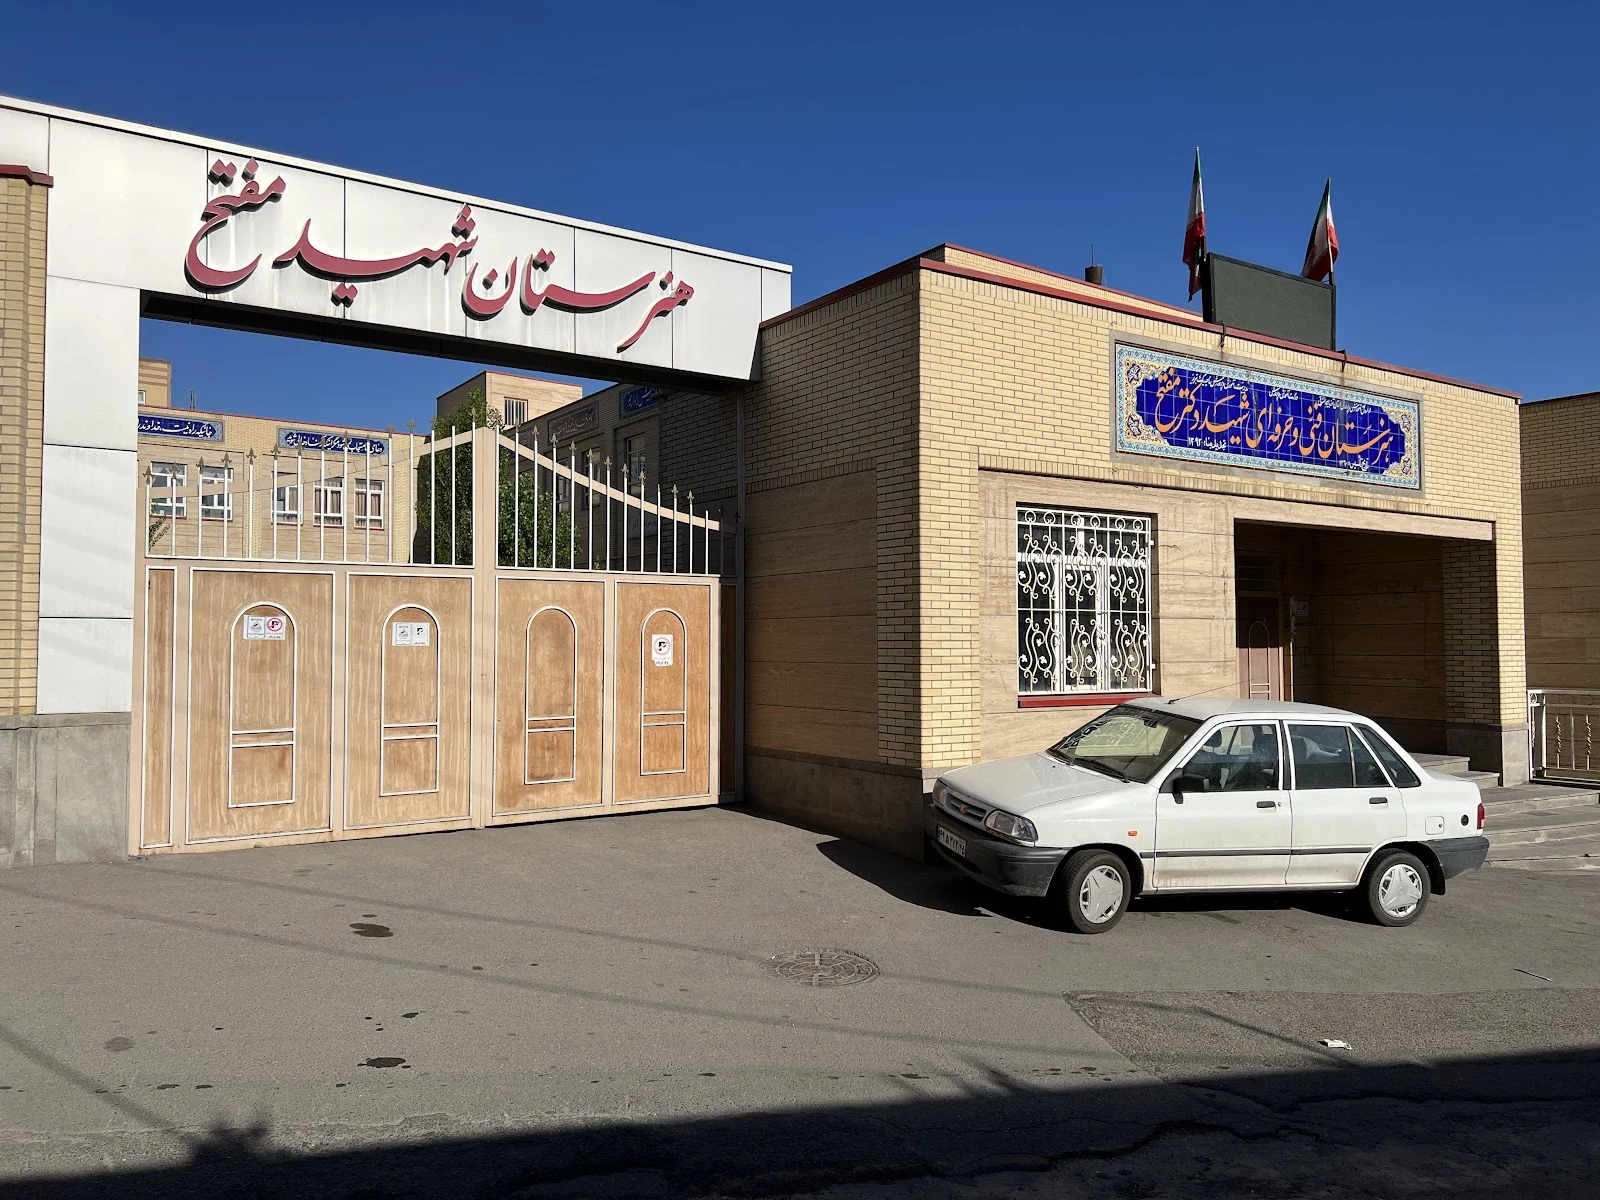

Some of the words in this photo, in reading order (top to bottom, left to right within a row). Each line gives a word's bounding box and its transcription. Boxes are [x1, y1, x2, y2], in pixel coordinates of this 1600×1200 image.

[185, 157, 286, 290] مفتح
[273, 203, 478, 306] شهید
[463, 249, 695, 352] هنرستان
[1155, 367, 1180, 432] مفتح
[1169, 383, 1201, 434] دکتر
[1198, 394, 1249, 444] شهید
[1245, 403, 1272, 448] ای
[1267, 406, 1293, 451] حرفه
[1318, 418, 1393, 465] هنرستان
